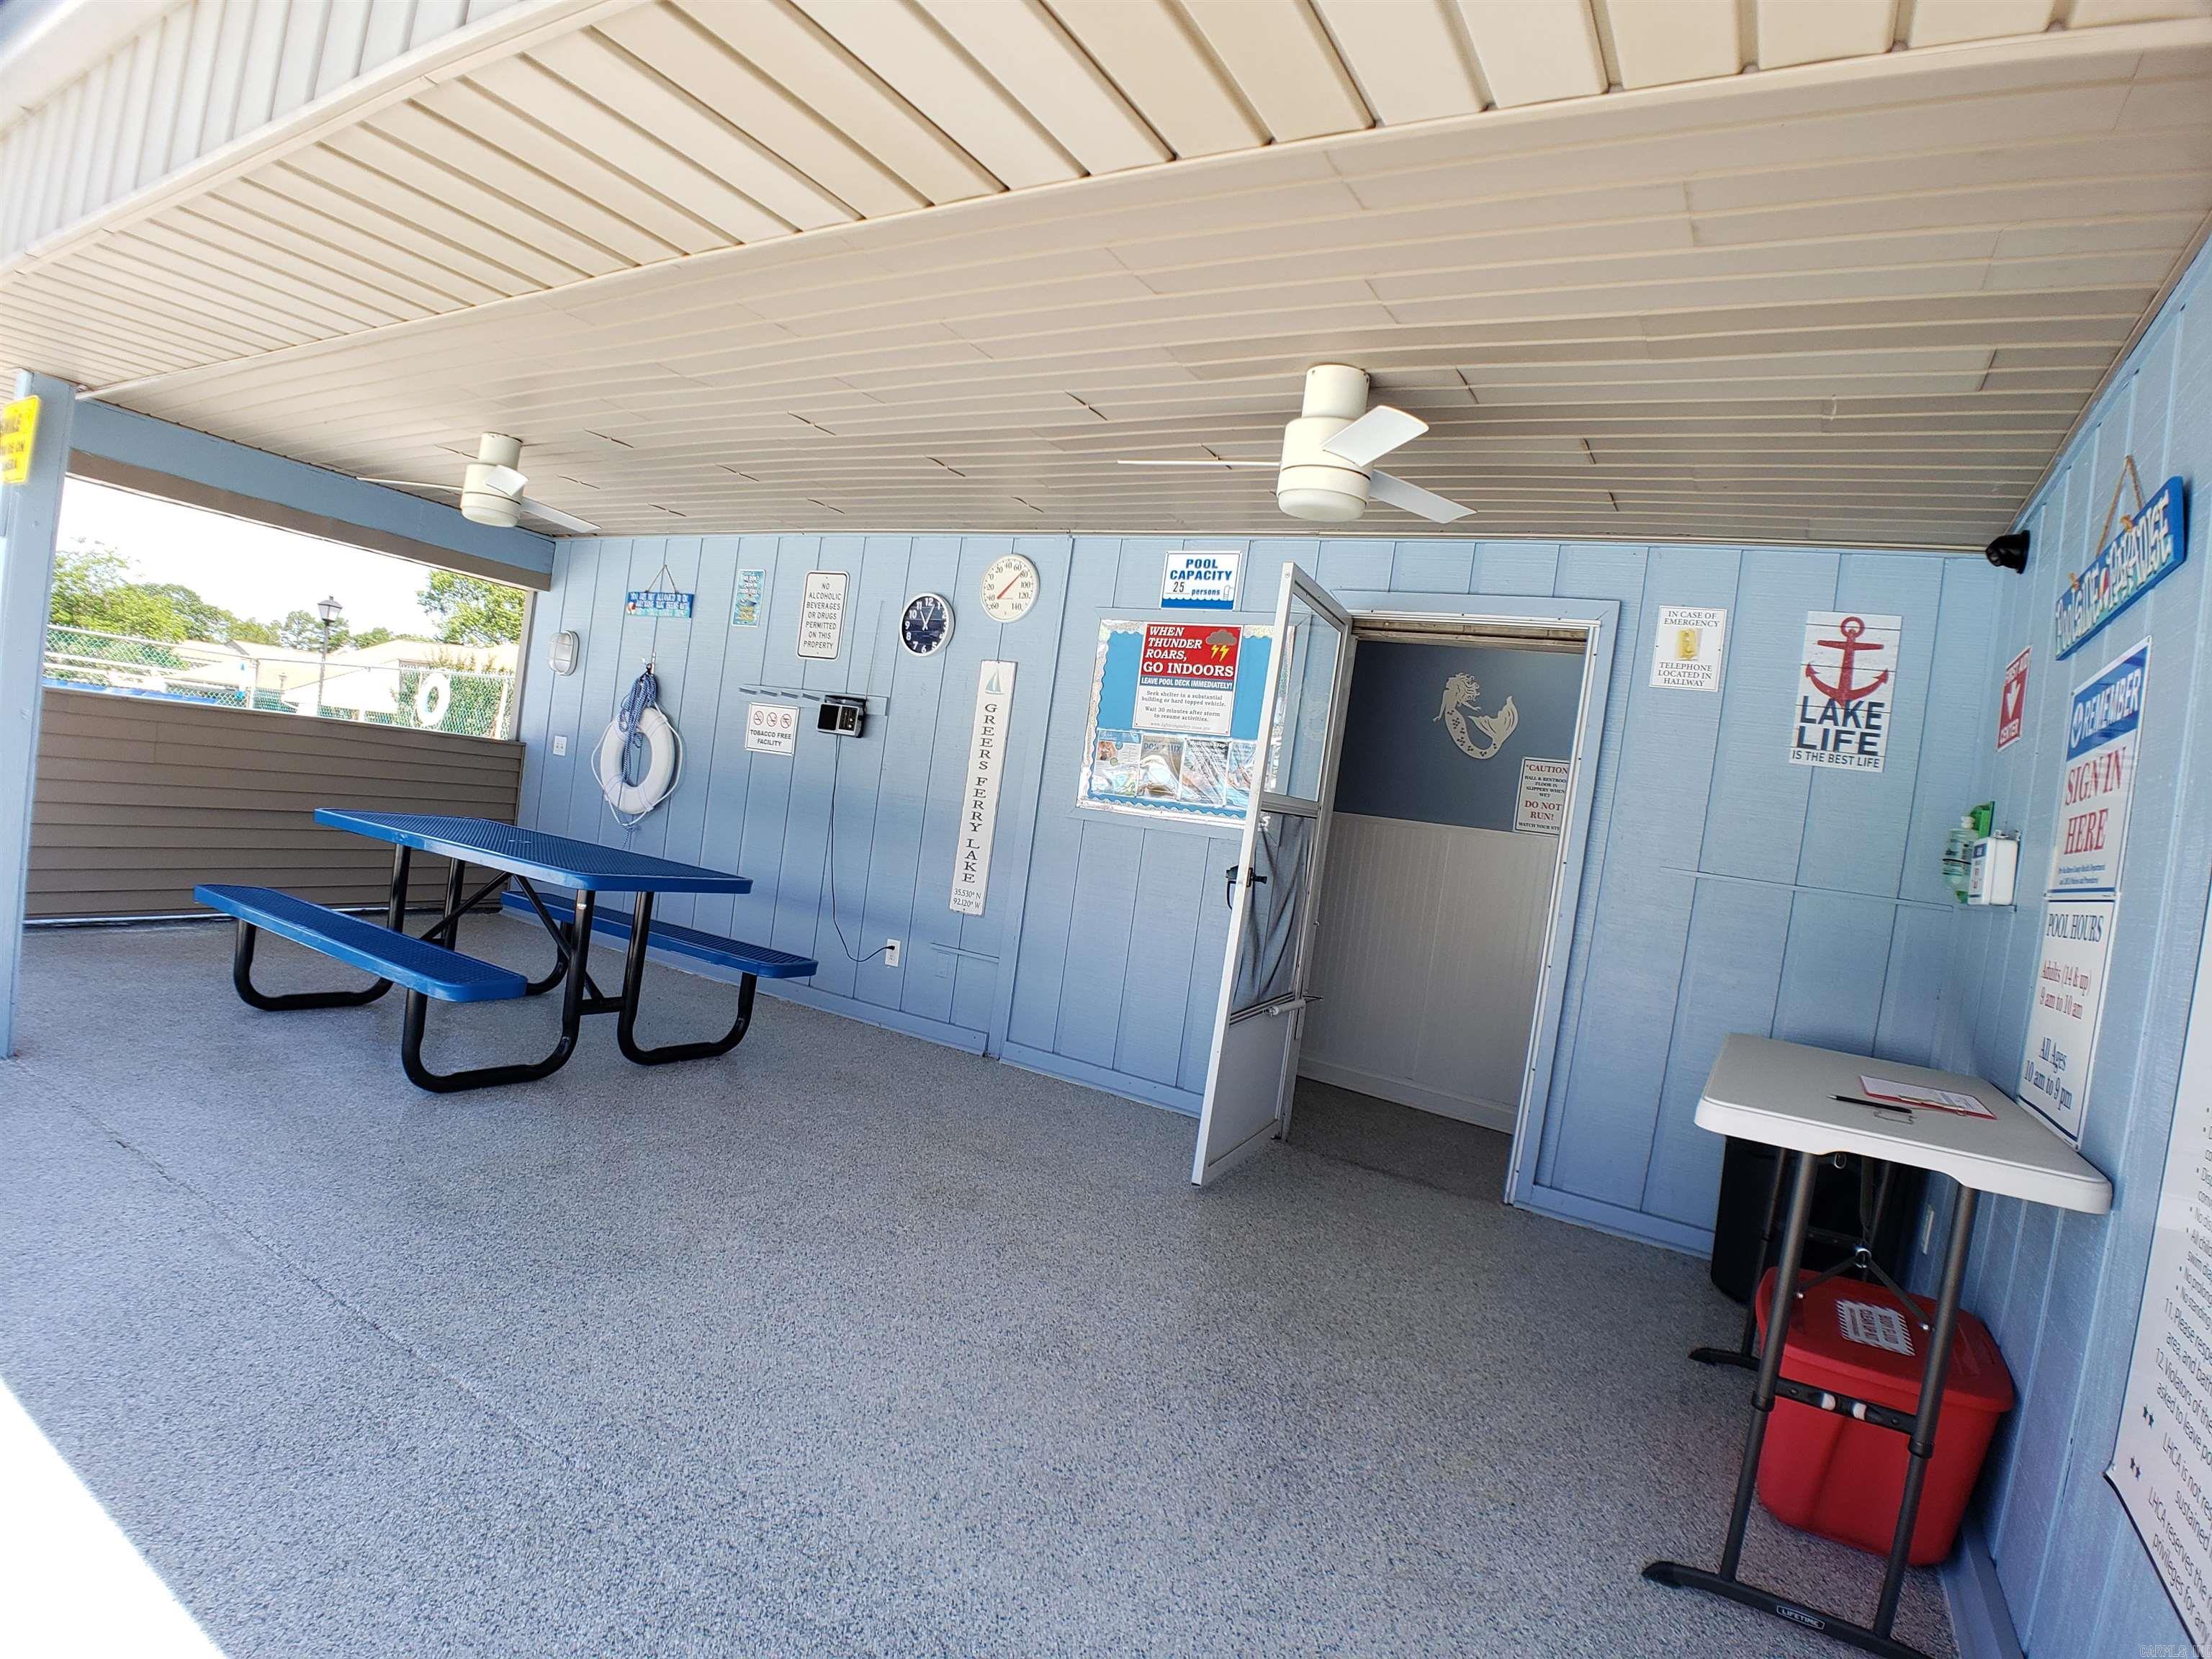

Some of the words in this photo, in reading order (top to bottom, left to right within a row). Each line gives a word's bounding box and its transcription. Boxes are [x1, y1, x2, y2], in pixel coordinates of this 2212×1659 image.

[1186, 559, 1218, 569] POOL
[1170, 570, 1232, 580] CAPACITY
[1173, 581, 1184, 593] 25
[809, 592, 841, 601] ALCOHOLIC
[925, 598, 934, 606] 12
[806, 601, 841, 611] BEVERAGES
[916, 601, 922, 610] 11
[909, 610, 917, 619] 10
[806, 621, 837, 630] PERMITTED
[904, 621, 910, 630] 9
[1664, 618, 1719, 627] EMERGENCY
[906, 631, 912, 641] 8
[1149, 626, 1185, 637] WHEN
[803, 640, 834, 649] PROPERTY
[912, 641, 919, 649] 7
[1148, 637, 1202, 649] THUNDER
[1145, 649, 1187, 662] ROARS,
[1143, 662, 1164, 673] GO
[1166, 662, 1234, 677] INDOORS
[1659, 662, 1712, 672] TELEPHONE
[1658, 670, 1699, 678] LOCATED
[1191, 680, 1233, 689] IMMEDIATELY!
[1663, 678, 1705, 687] HALLWAY
[2081, 667, 2141, 739] REMEMBER
[1801, 696, 1885, 730] LAKE
[750, 729, 775, 738] TOBACCO
[979, 703, 998, 770] GREERS
[757, 738, 782, 747] FACILITY
[1797, 725, 1881, 756] LIFE
[1792, 750, 1803, 760] IS
[1805, 751, 1826, 763] THE
[1828, 753, 1855, 766] BEST
[1857, 756, 1880, 768] LIFE
[2065, 756, 2103, 806] SIGN
[2103, 747, 2127, 794] IN
[970, 777, 988, 832] FERRY
[1524, 800, 1539, 809] DO
[1541, 801, 1563, 811] NOT
[1530, 811, 1554, 821] RUN!
[2064, 808, 2109, 855] HERE
[961, 838, 980, 884] LAKE
[2046, 913, 2069, 938] POOL
[2069, 914, 2104, 943] HOURS
[2038, 1036, 2051, 1062] All
[2051, 1043, 2067, 1074] Ages
[2023, 1060, 2033, 1083] 10
[2033, 1070, 2045, 1092] am
[2046, 1075, 2054, 1101] to
[2058, 1084, 2072, 1111] pm
[2173, 1307, 2195, 1344] Please
[2165, 1357, 2193, 1406] Violators
[2157, 1382, 2176, 1413] asked
[2162, 1431, 2181, 1473] LHCA
[2148, 1486, 2166, 1528] LHCA
[2165, 1522, 2195, 1577] reserves
[2194, 1568, 2207, 1602] the
[2152, 1533, 2183, 1596] privileges
[2183, 1586, 2196, 1615] for
[1782, 1609, 1818, 1627] LIFETIME
